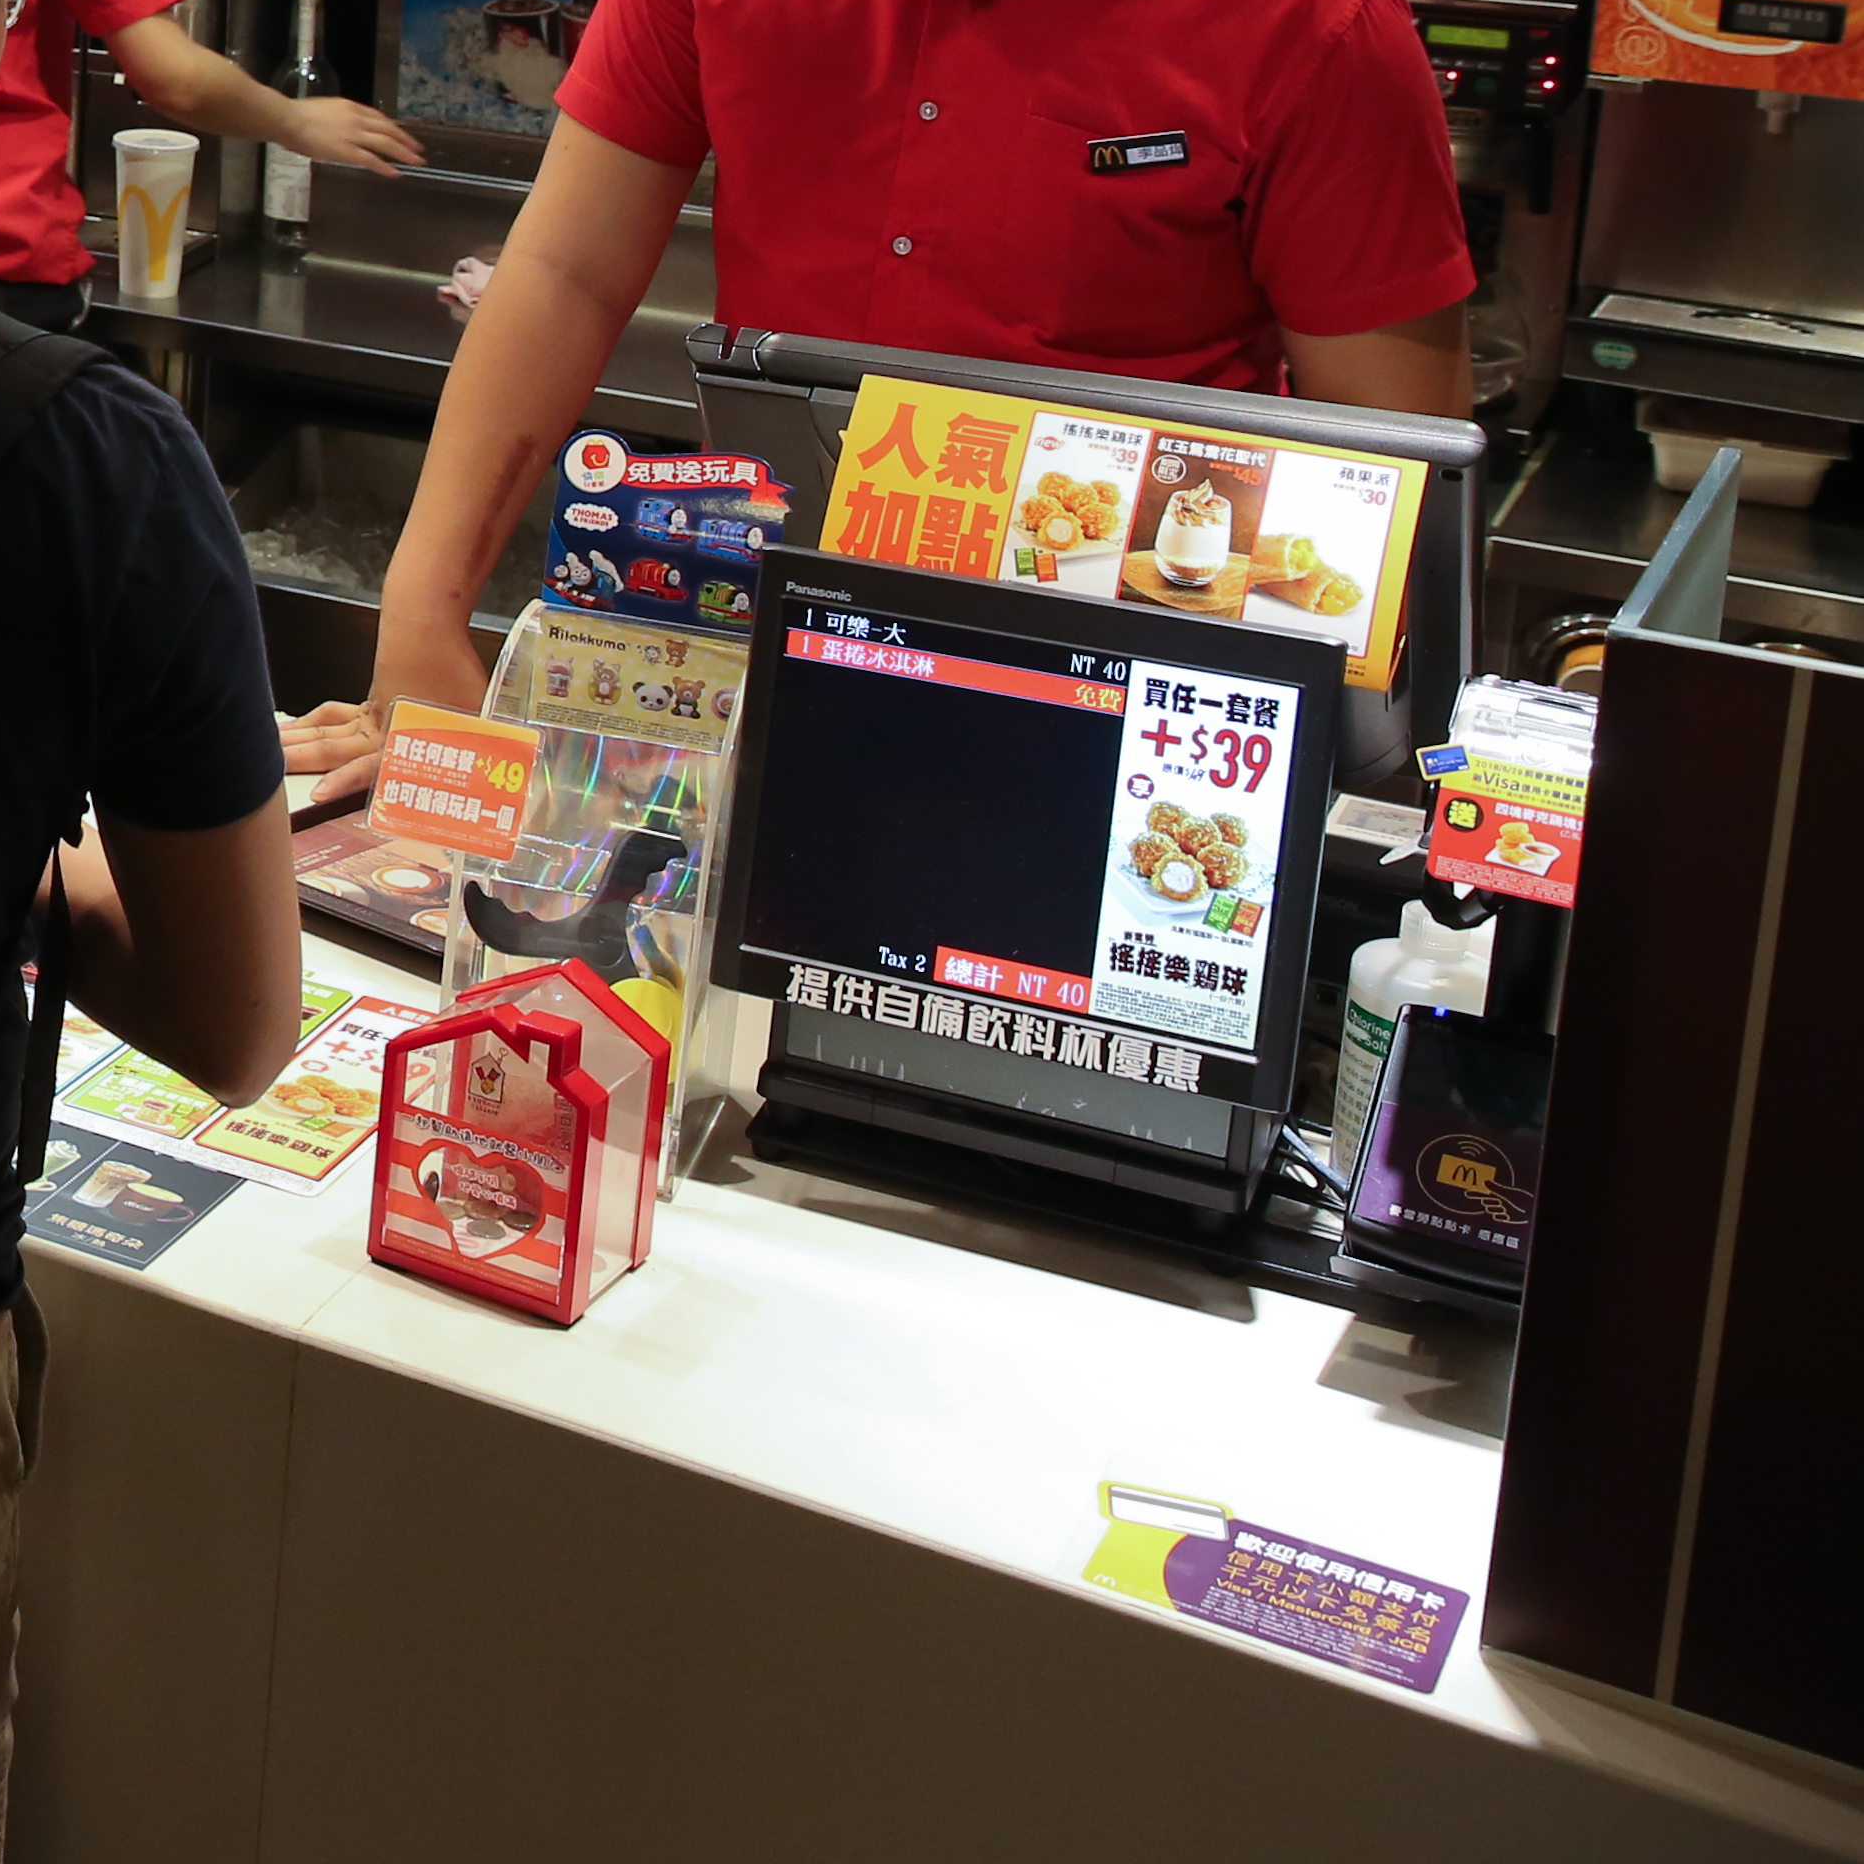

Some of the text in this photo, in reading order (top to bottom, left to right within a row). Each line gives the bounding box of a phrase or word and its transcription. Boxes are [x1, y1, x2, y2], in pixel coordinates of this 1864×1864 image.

[856, 400, 1021, 495] 人氣
[1034, 437, 1065, 450] new
[1111, 447, 1139, 465] $39
[627, 460, 758, 486] 免費送玩具
[1339, 467, 1391, 487] 蘋果派
[1358, 490, 1387, 506] $30
[571, 508, 613, 522] THOMAS
[835, 481, 1000, 581] 加點
[786, 581, 852, 602] Panasonic
[548, 624, 627, 653] Rilakkuma
[806, 609, 1126, 681] 1 可樂-大 NT 40
[802, 636, 1122, 713] 1 蛋捲冰淇淋 免費
[1144, 677, 1280, 730] 買任一套餐
[392, 735, 476, 773] 買任何套餐
[476, 755, 525, 794] +$49
[1141, 718, 1273, 793] +$39
[383, 779, 516, 831] 也可獲得玩具一個
[1447, 800, 1477, 829] 送
[879, 947, 1085, 1006] Tax 2 總計 NT 40
[787, 964, 1203, 1094] 提供自備飲料杯優惠
[1348, 1009, 1391, 1041] Chlorine
[1227, 1549, 1441, 1628] 信用卡小額支付
[1234, 1531, 1446, 1612] 歡迎使用信用卡
[1216, 1577, 1253, 1597] Visa
[1268, 1594, 1372, 1636] MasterCard
[1389, 1636, 1428, 1654] JCB
[1221, 1565, 1431, 1644] 千元以下免簽名
